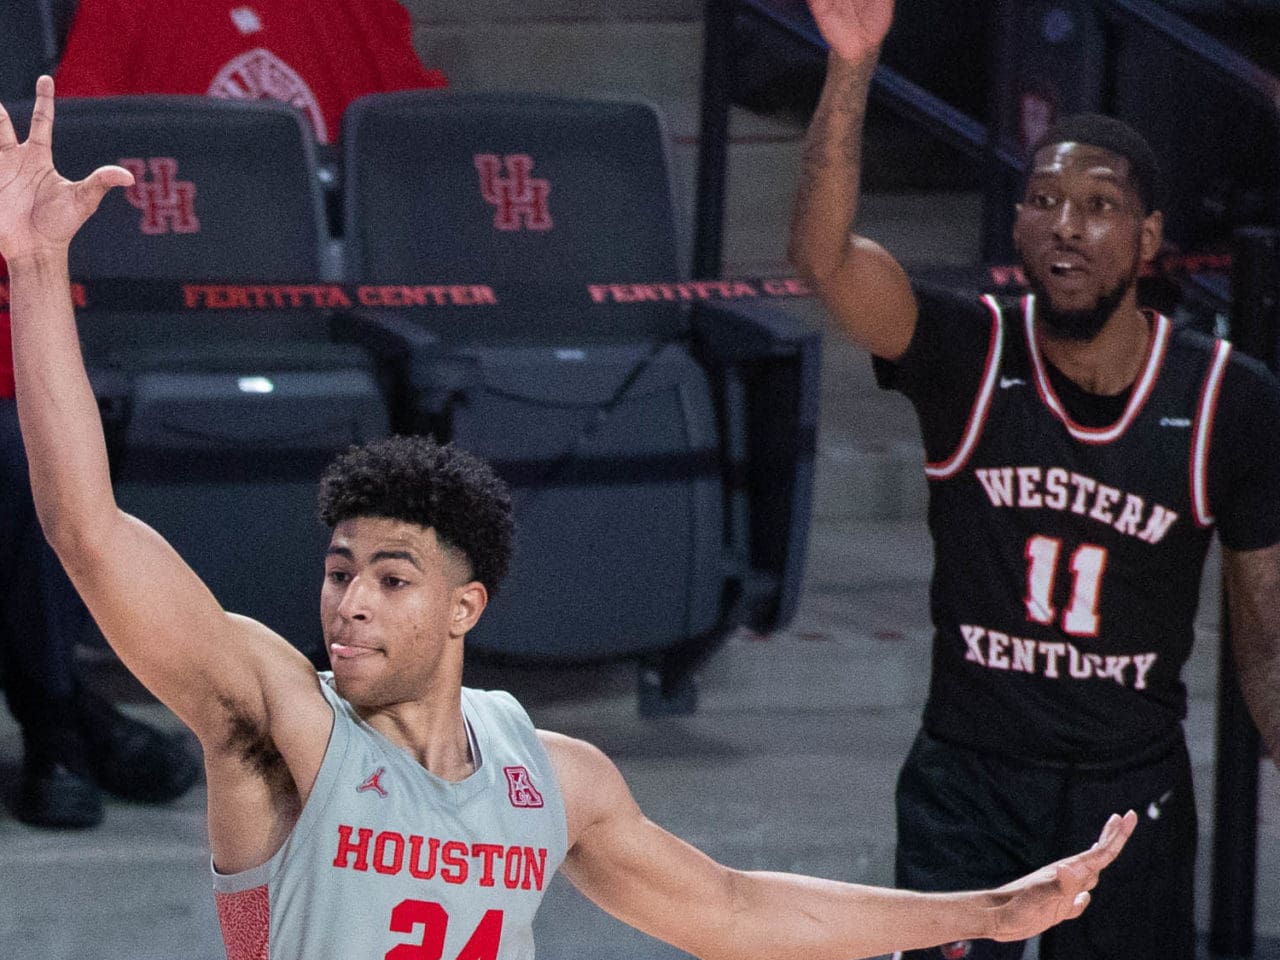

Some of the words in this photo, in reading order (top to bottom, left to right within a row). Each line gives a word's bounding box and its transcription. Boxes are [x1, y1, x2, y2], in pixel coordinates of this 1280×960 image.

[120, 157, 199, 234] UH
[473, 154, 553, 231] UH
[183, 284, 351, 308] FERTITTA
[358, 284, 496, 306] CENTER
[587, 281, 756, 303] FERTITTA
[975, 467, 1178, 544] WESTERN
[1025, 534, 1108, 637] 11
[333, 824, 548, 891] HOUSTON
